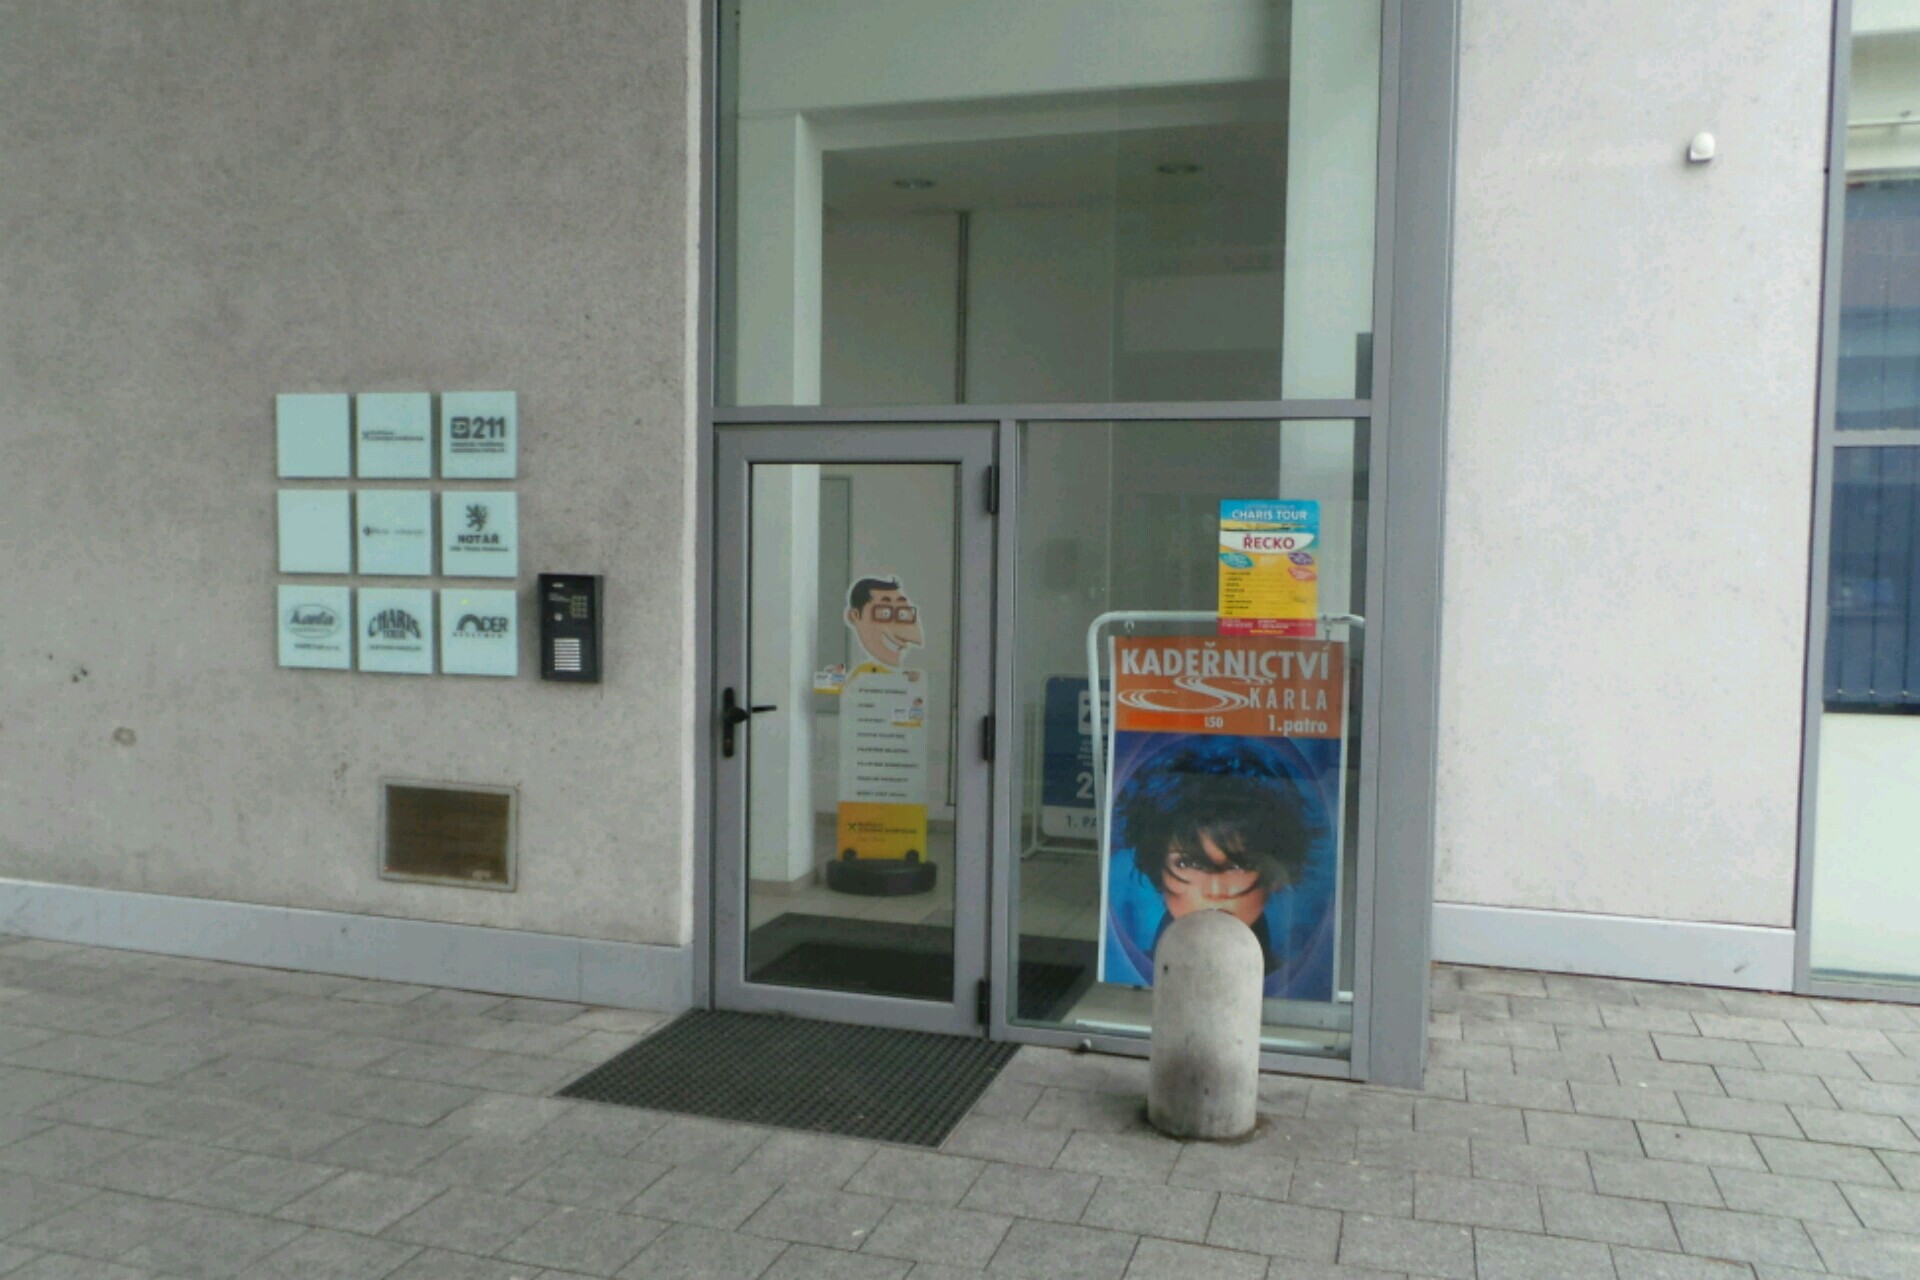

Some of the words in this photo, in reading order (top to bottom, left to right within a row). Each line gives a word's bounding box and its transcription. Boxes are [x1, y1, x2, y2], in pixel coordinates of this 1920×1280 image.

[472, 416, 505, 439] 211
[1232, 509, 1273, 520] CHARIS
[1276, 511, 1308, 520] TOUR
[1243, 533, 1295, 549] ŘECKO
[1121, 641, 1329, 680] KADEŘNICTVÍ
